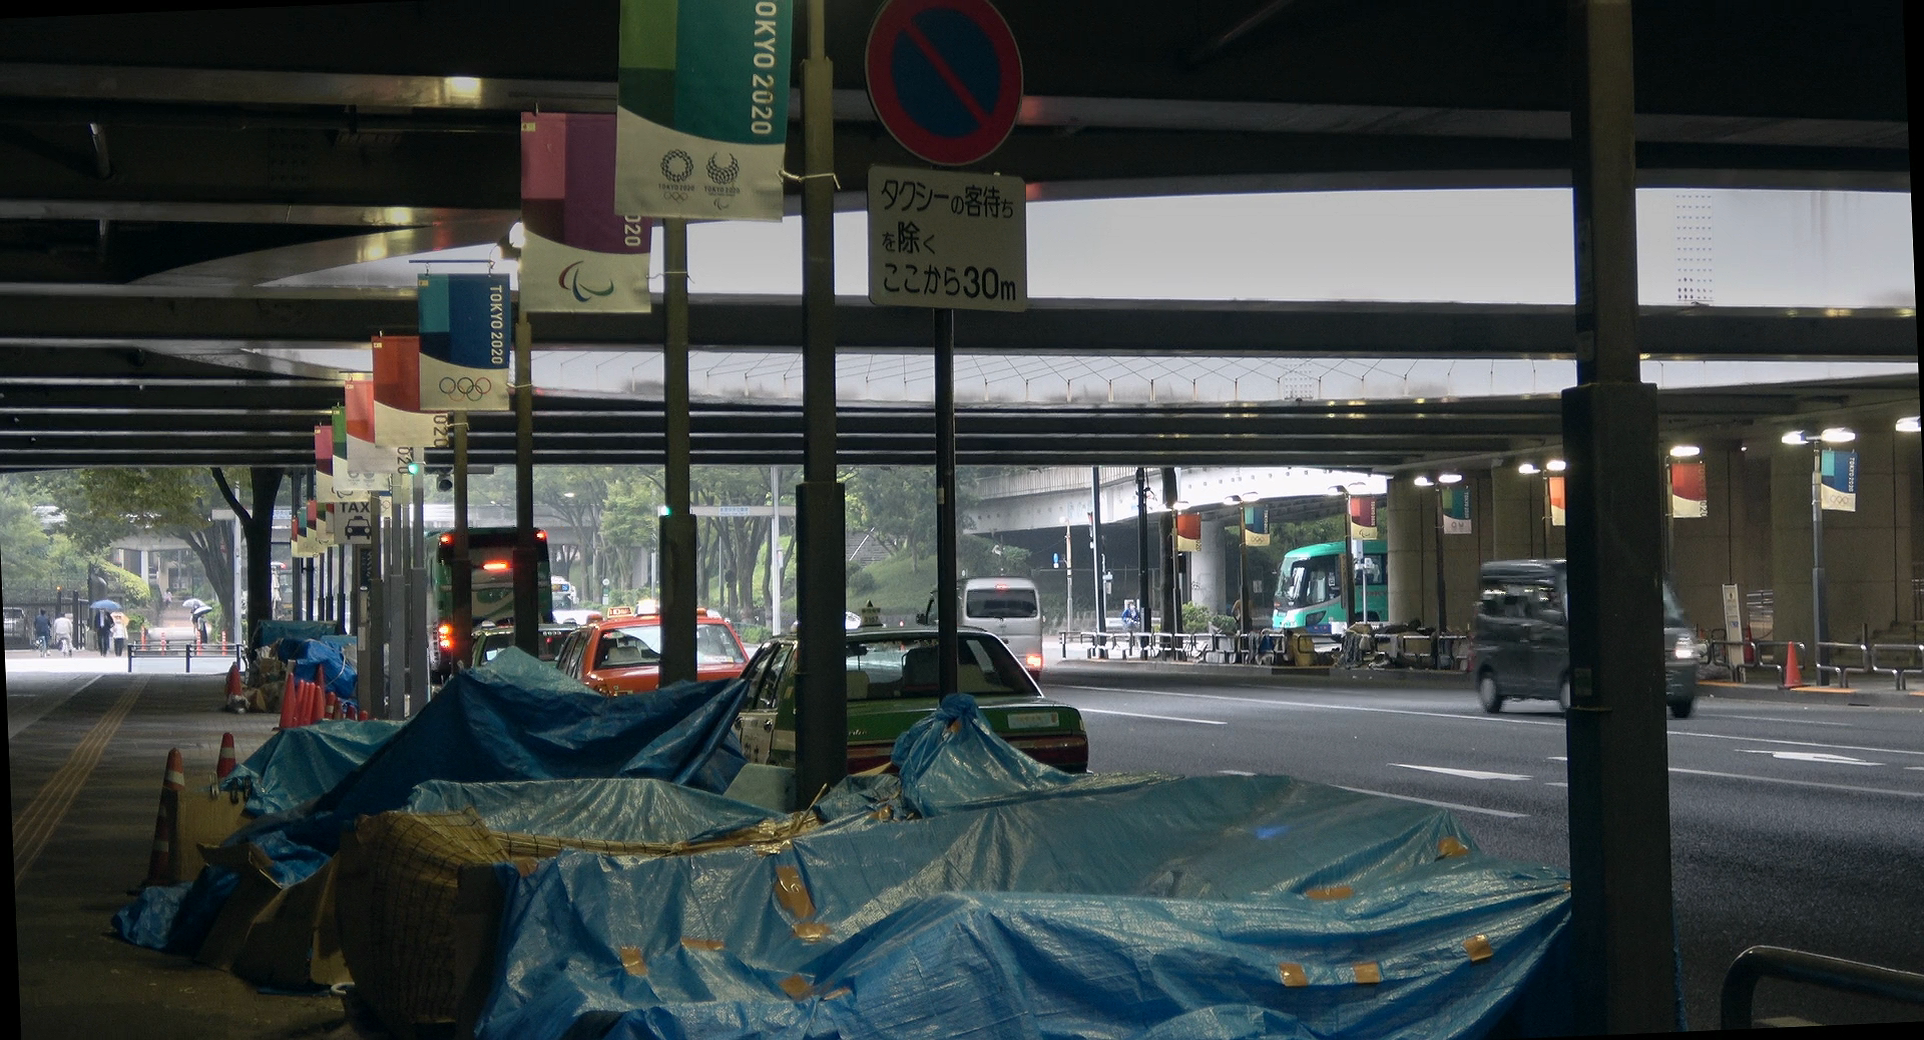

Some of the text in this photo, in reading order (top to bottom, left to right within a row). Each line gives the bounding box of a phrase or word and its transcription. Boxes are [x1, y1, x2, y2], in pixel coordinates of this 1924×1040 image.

[750, 73, 775, 135] 2020
[881, 180, 1014, 218] タクシーの客待ち
[882, 221, 936, 254] を除く
[884, 263, 1016, 301] ここから30m
[489, 284, 504, 365] TOKYO 2020
[433, 415, 448, 448] 020
